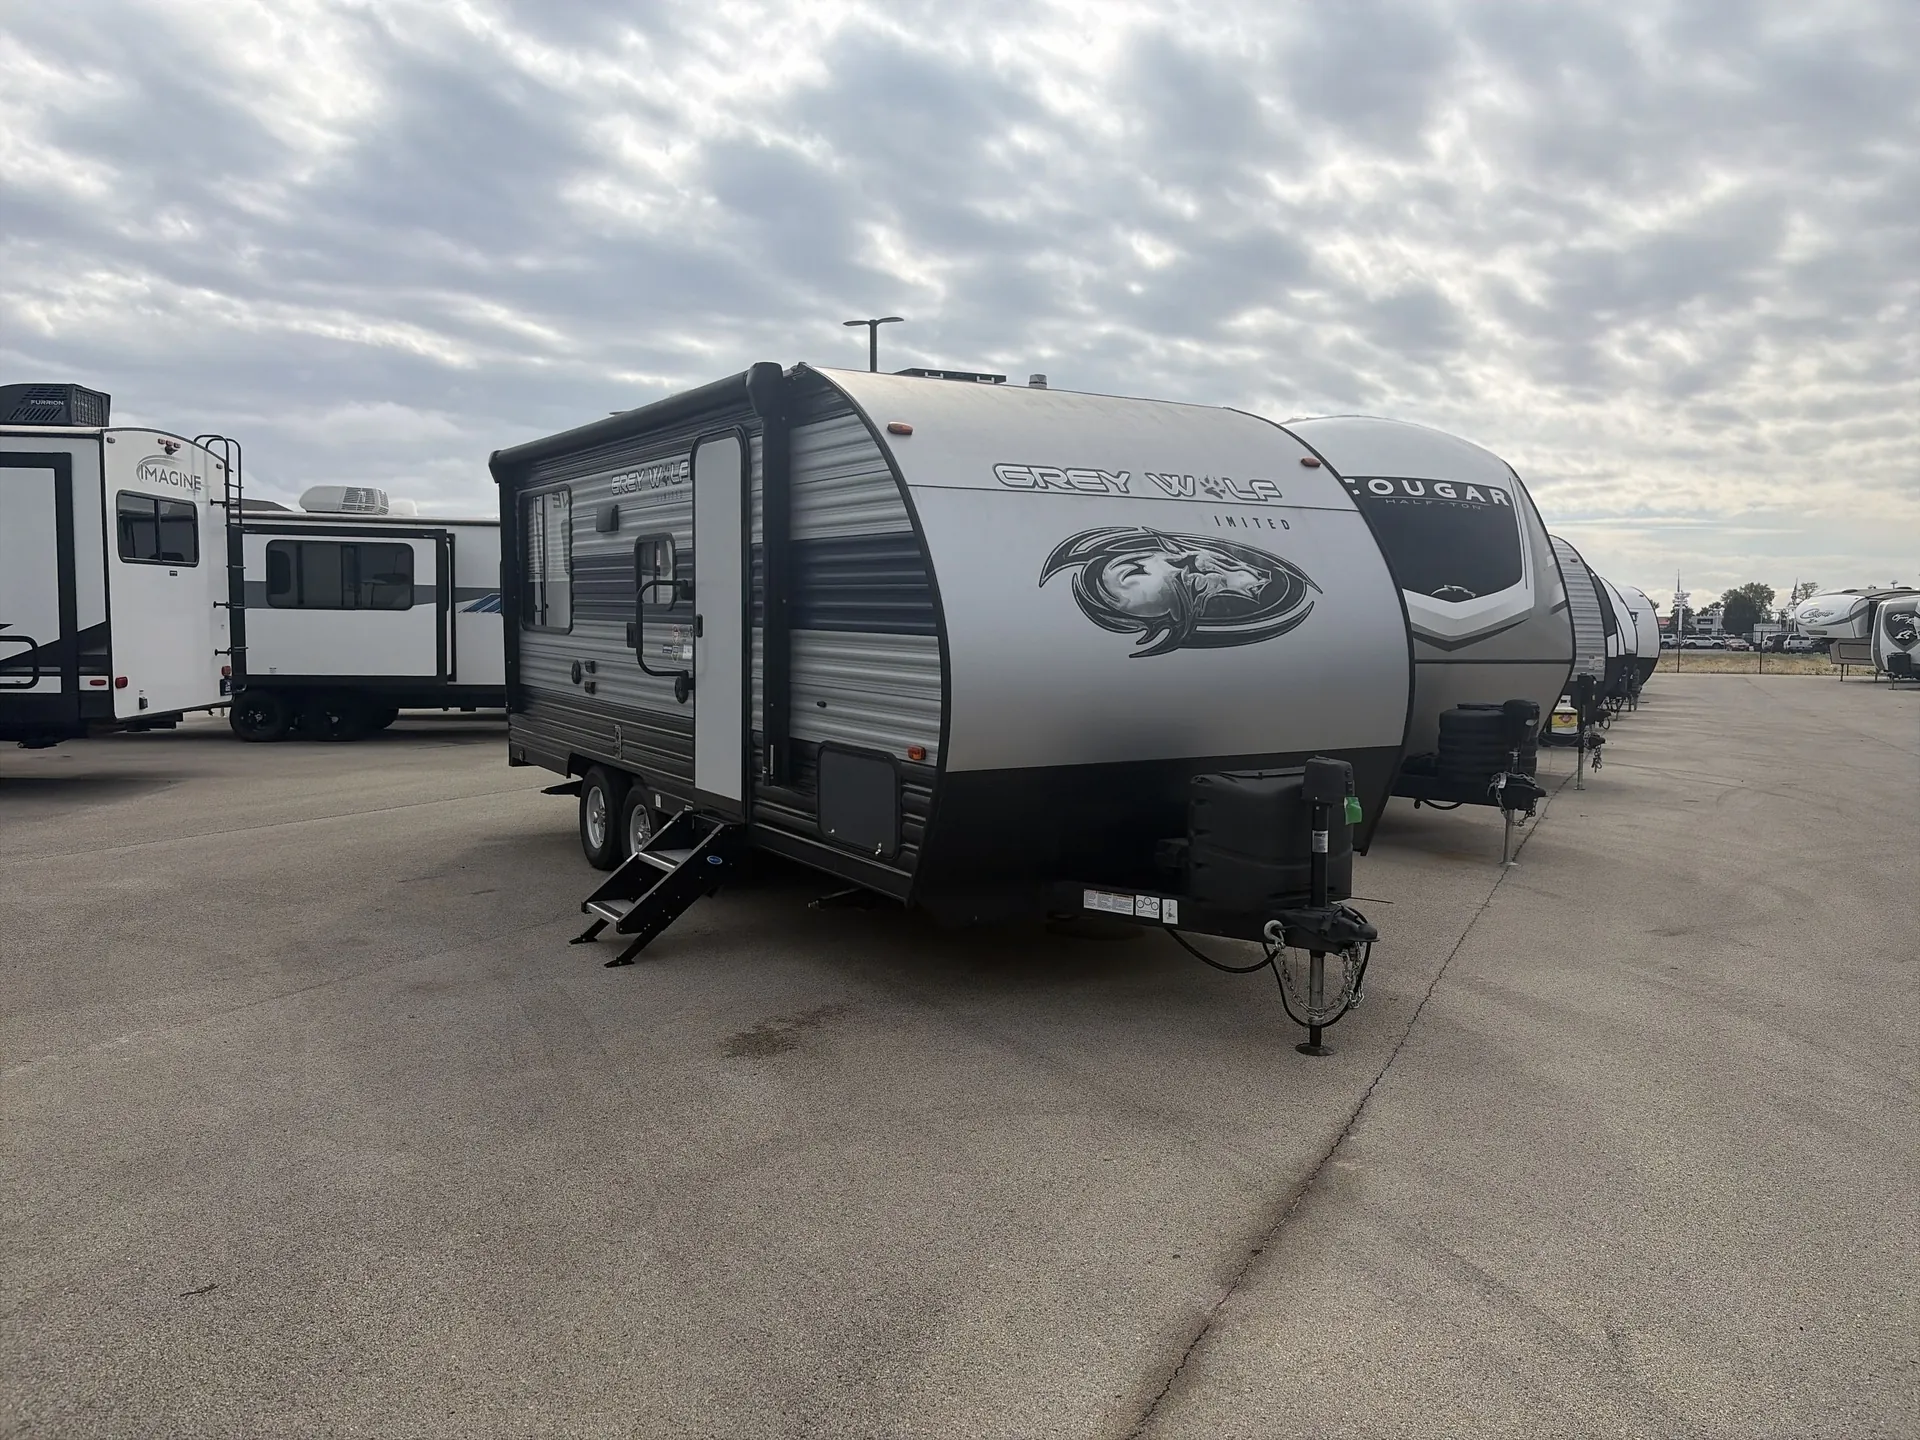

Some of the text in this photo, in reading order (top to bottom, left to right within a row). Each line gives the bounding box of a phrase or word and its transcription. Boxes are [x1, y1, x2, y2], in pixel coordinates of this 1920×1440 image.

[140, 463, 202, 490] IMAGINE
[611, 468, 645, 495] GREY
[992, 463, 1131, 494] GREY
[1385, 498, 1482, 511] HALF-TON
[1213, 515, 1291, 531] IMITED
